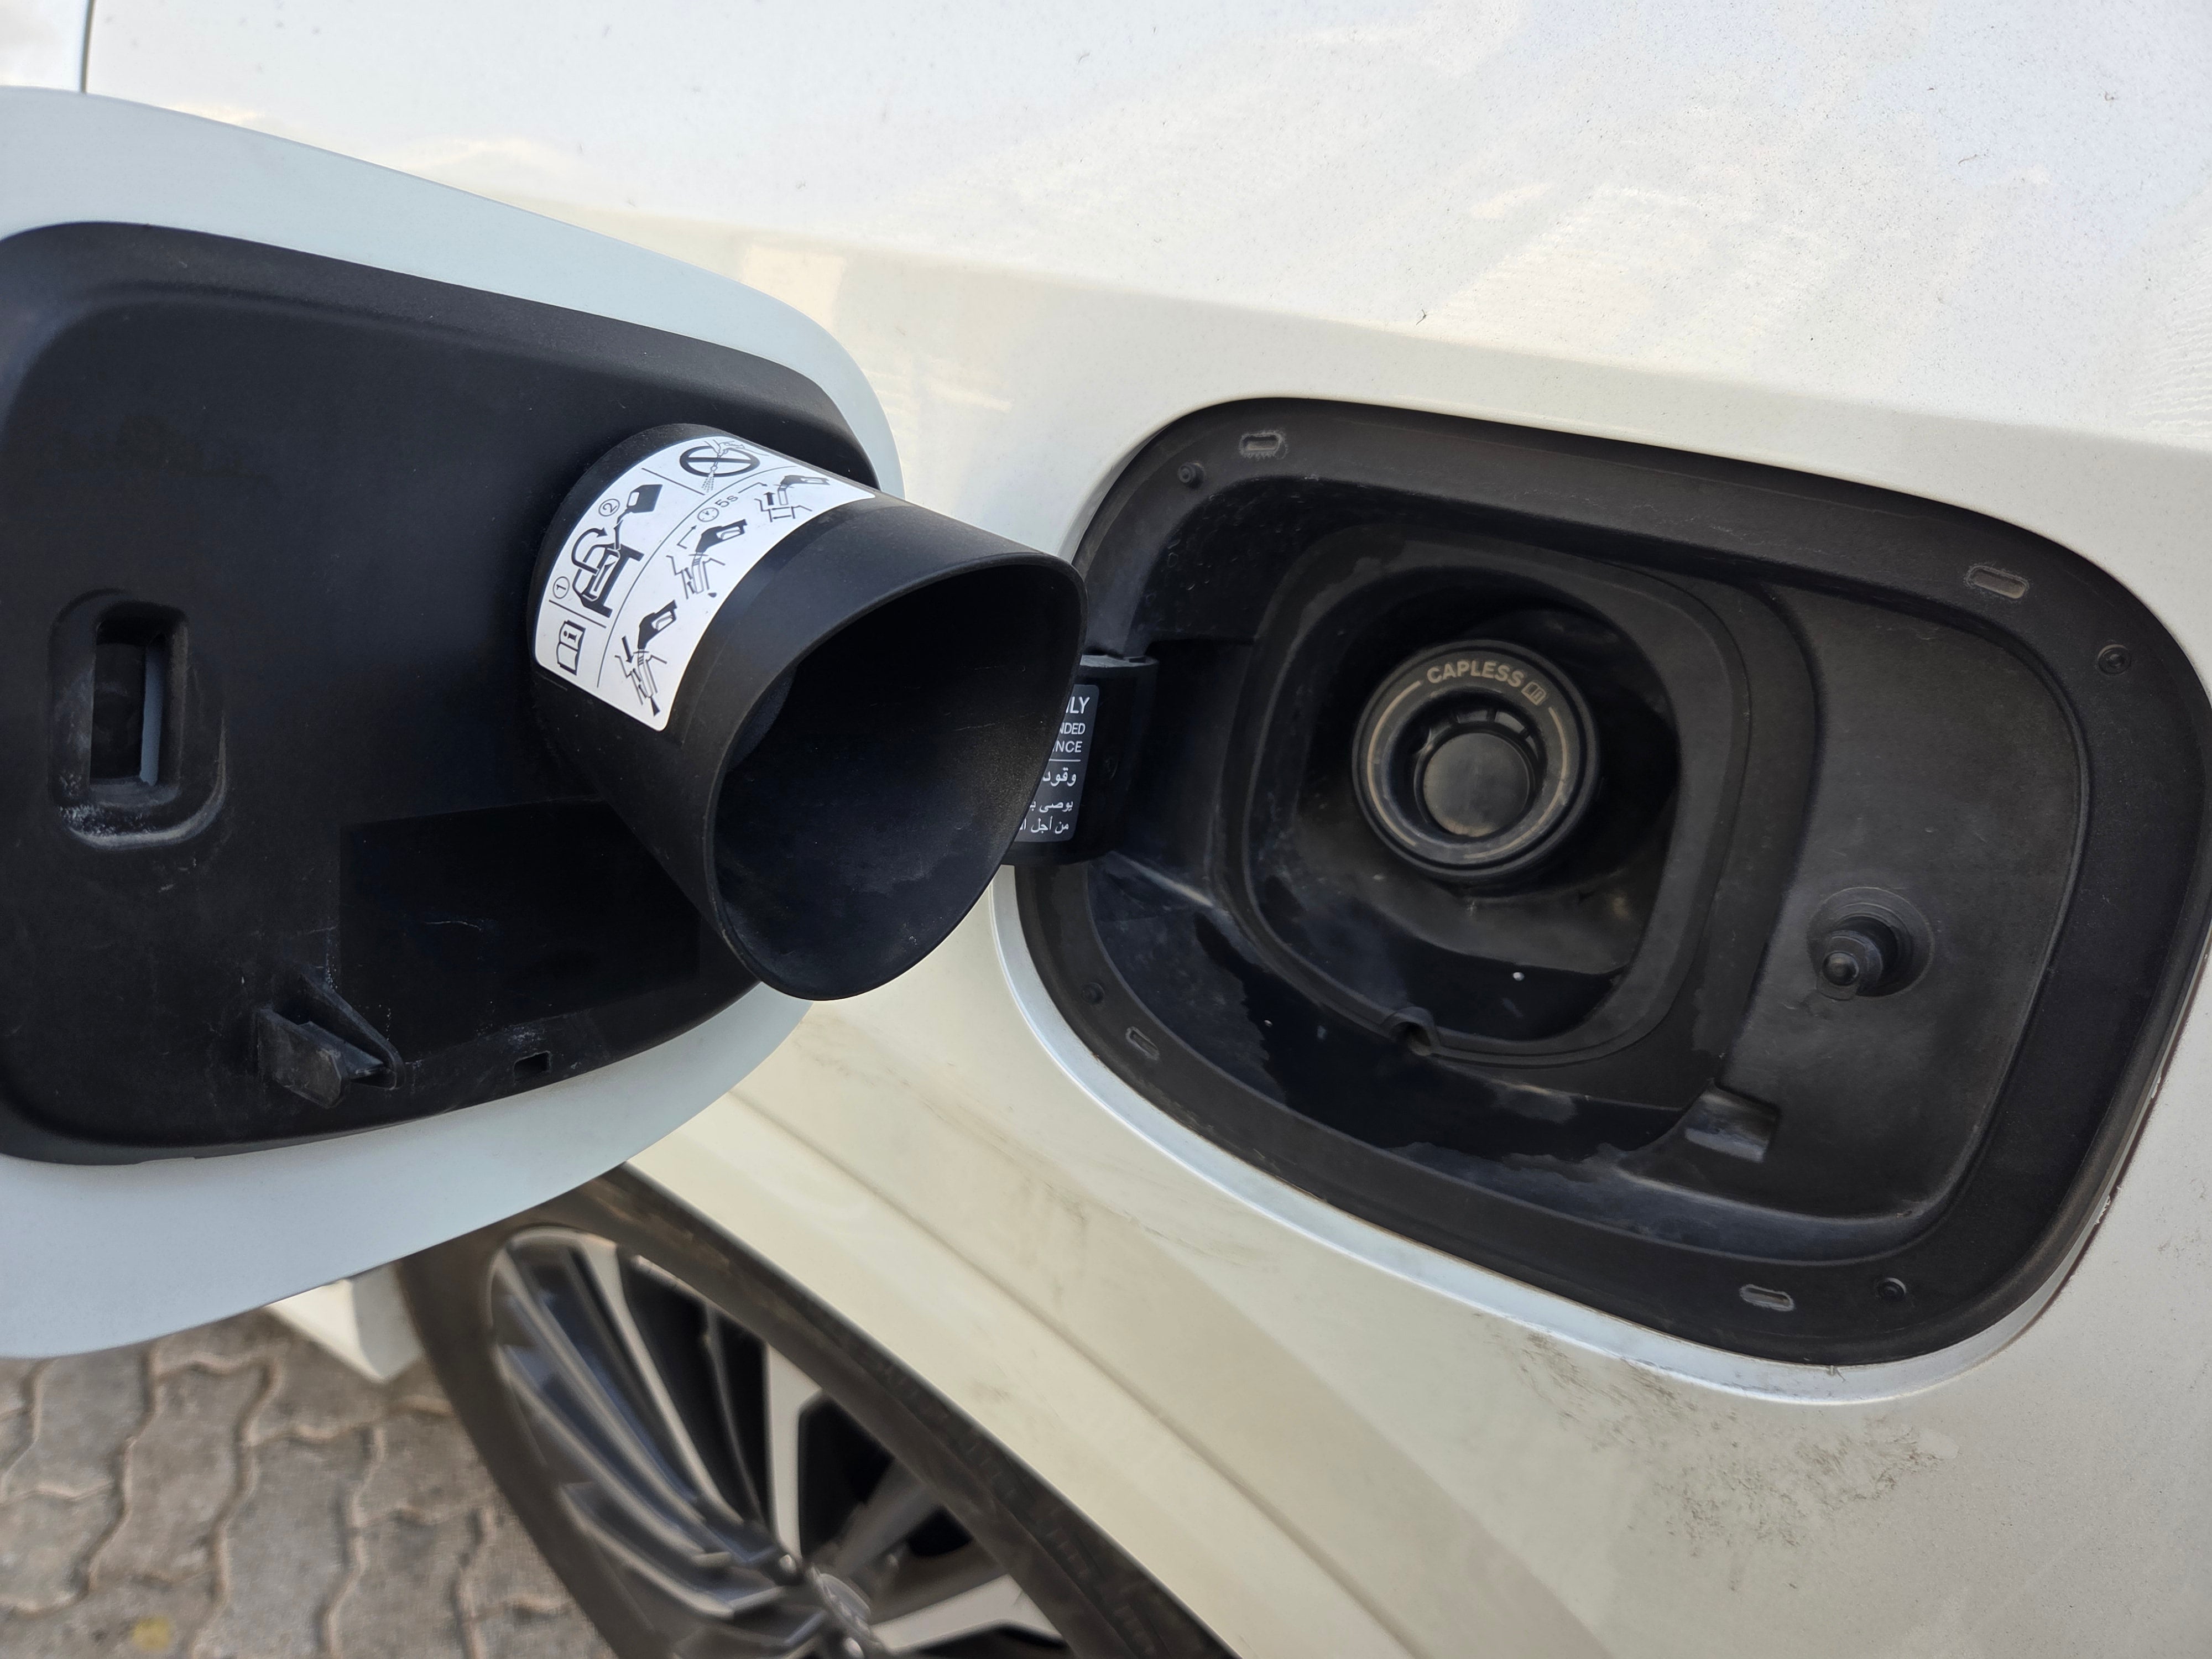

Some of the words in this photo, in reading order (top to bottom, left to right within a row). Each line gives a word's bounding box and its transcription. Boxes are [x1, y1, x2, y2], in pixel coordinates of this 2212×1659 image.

[715, 495, 738, 508] 5s
[1427, 660, 1525, 687] CAPLESS
[1052, 740, 1083, 753] NCE
[1043, 767, 1077, 786] وقود
[1031, 816, 1053, 833] أجل
[1055, 821, 1069, 834] من
